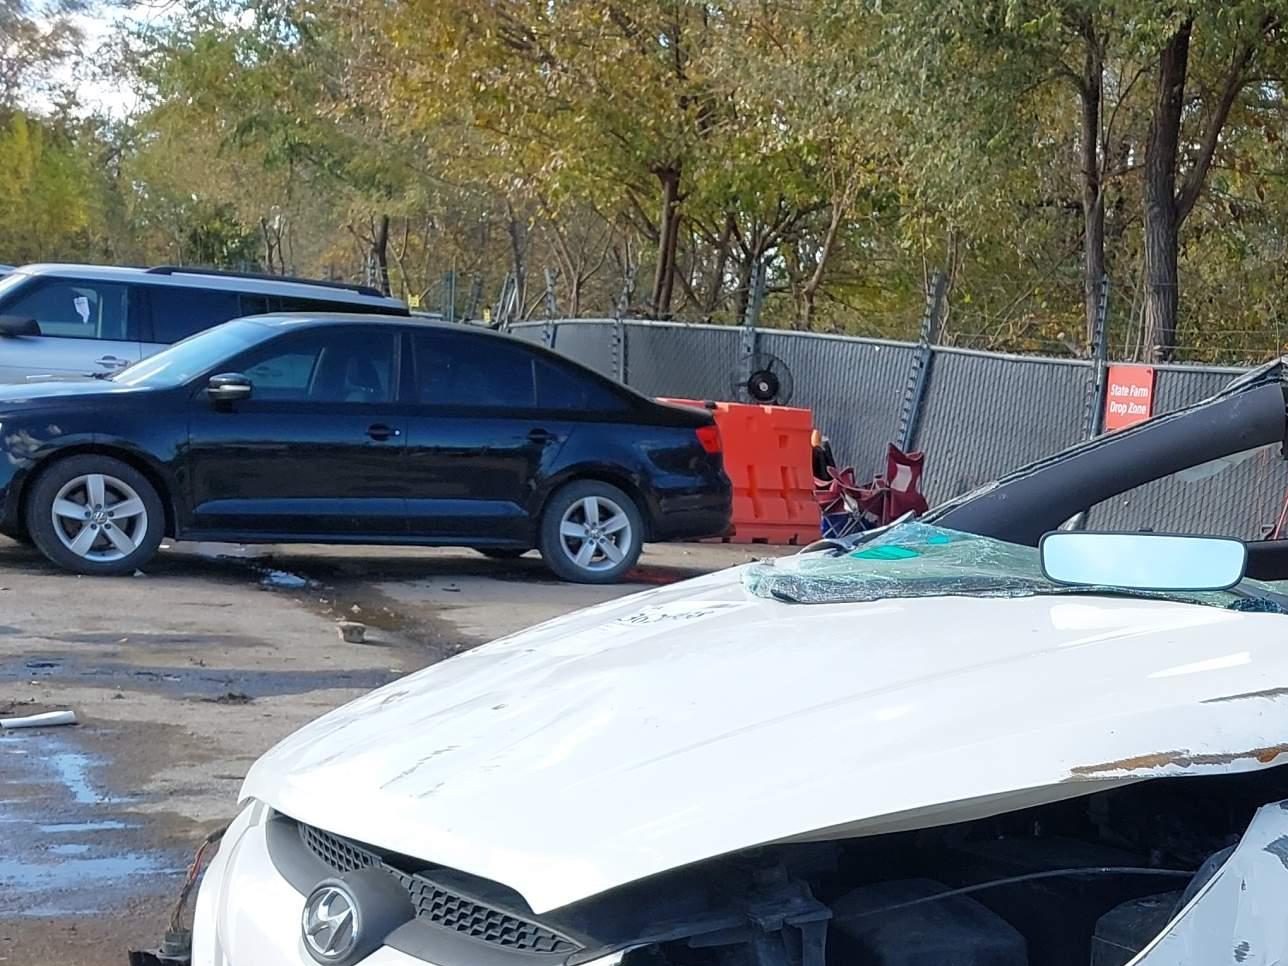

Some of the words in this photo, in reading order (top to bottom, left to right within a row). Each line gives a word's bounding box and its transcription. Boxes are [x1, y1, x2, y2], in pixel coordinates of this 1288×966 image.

[1110, 384, 1129, 396] State
[1130, 385, 1149, 397] Farm
[1110, 401, 1127, 416] Drop
[1128, 403, 1147, 415] Zone
